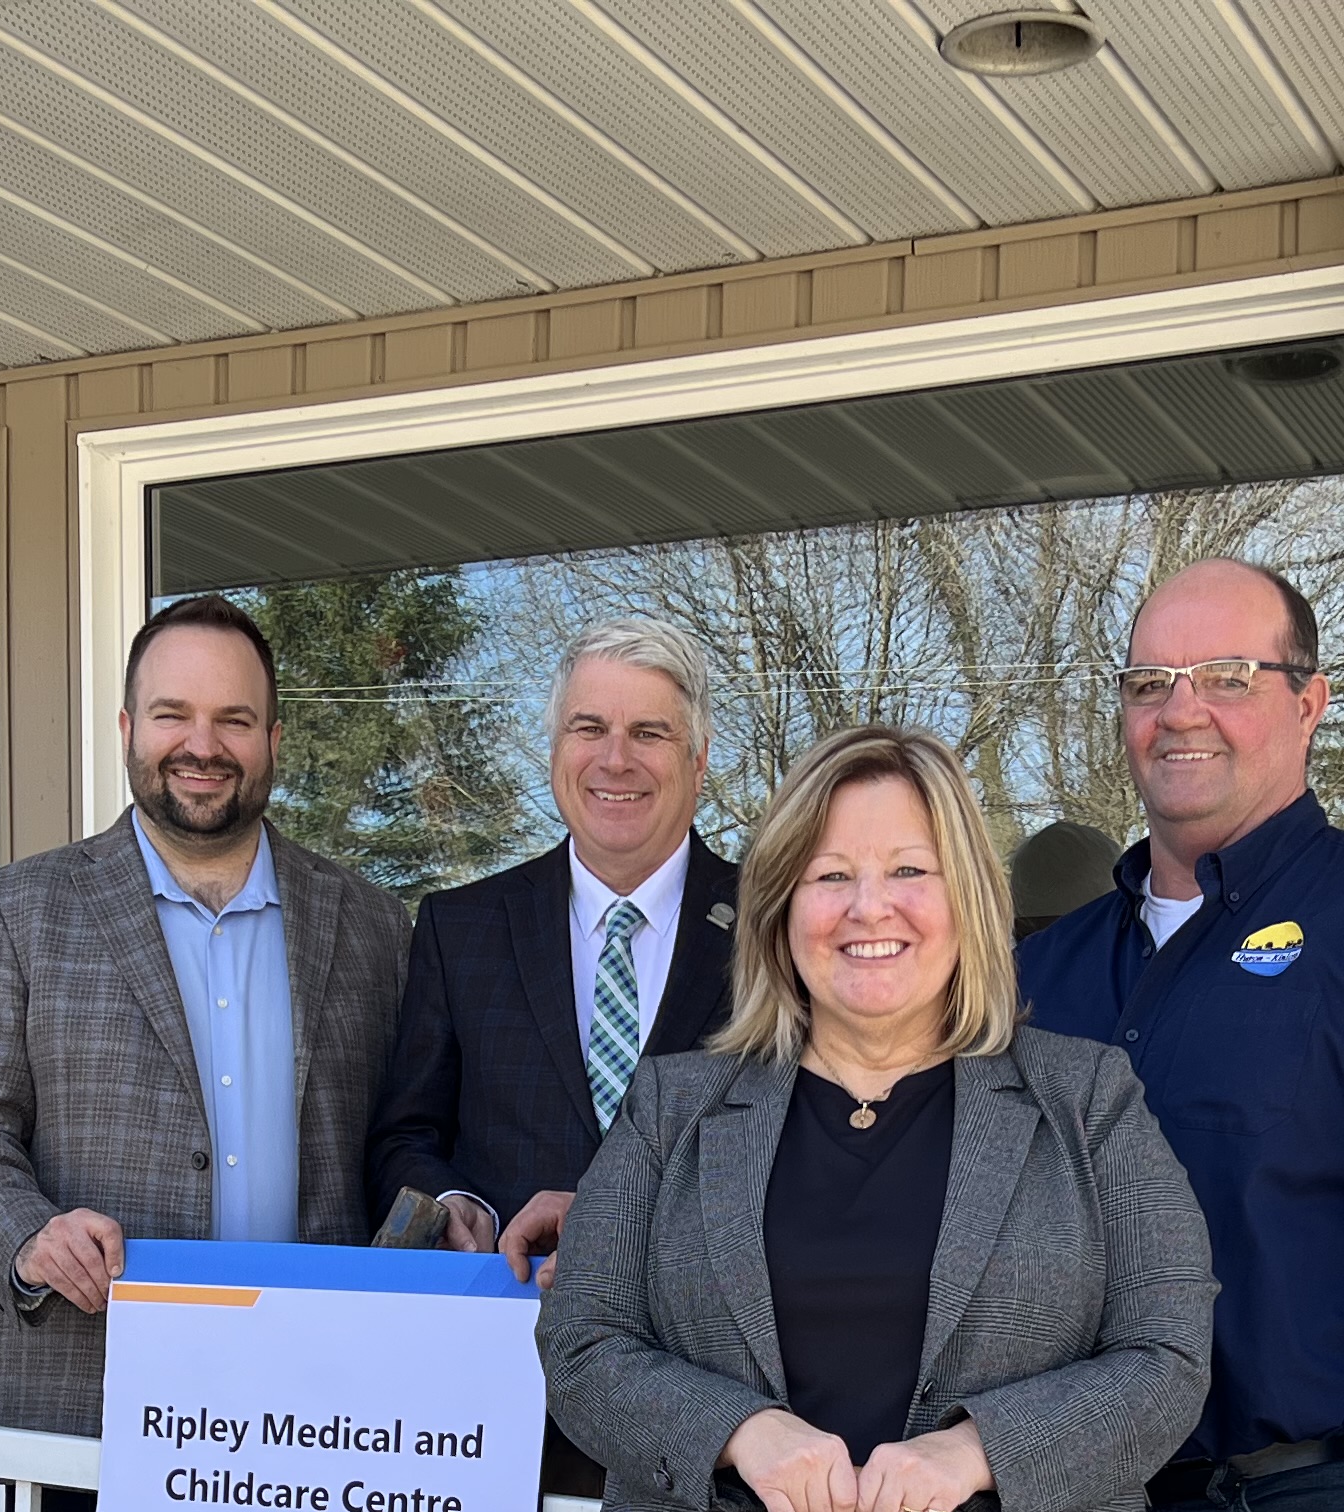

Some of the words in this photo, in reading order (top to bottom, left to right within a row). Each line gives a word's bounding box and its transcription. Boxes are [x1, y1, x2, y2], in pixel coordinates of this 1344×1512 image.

[141, 1405, 250, 1453] Ripley
[261, 1413, 403, 1454] Medical
[414, 1423, 485, 1459] and
[164, 1468, 330, 1511] Childcare
